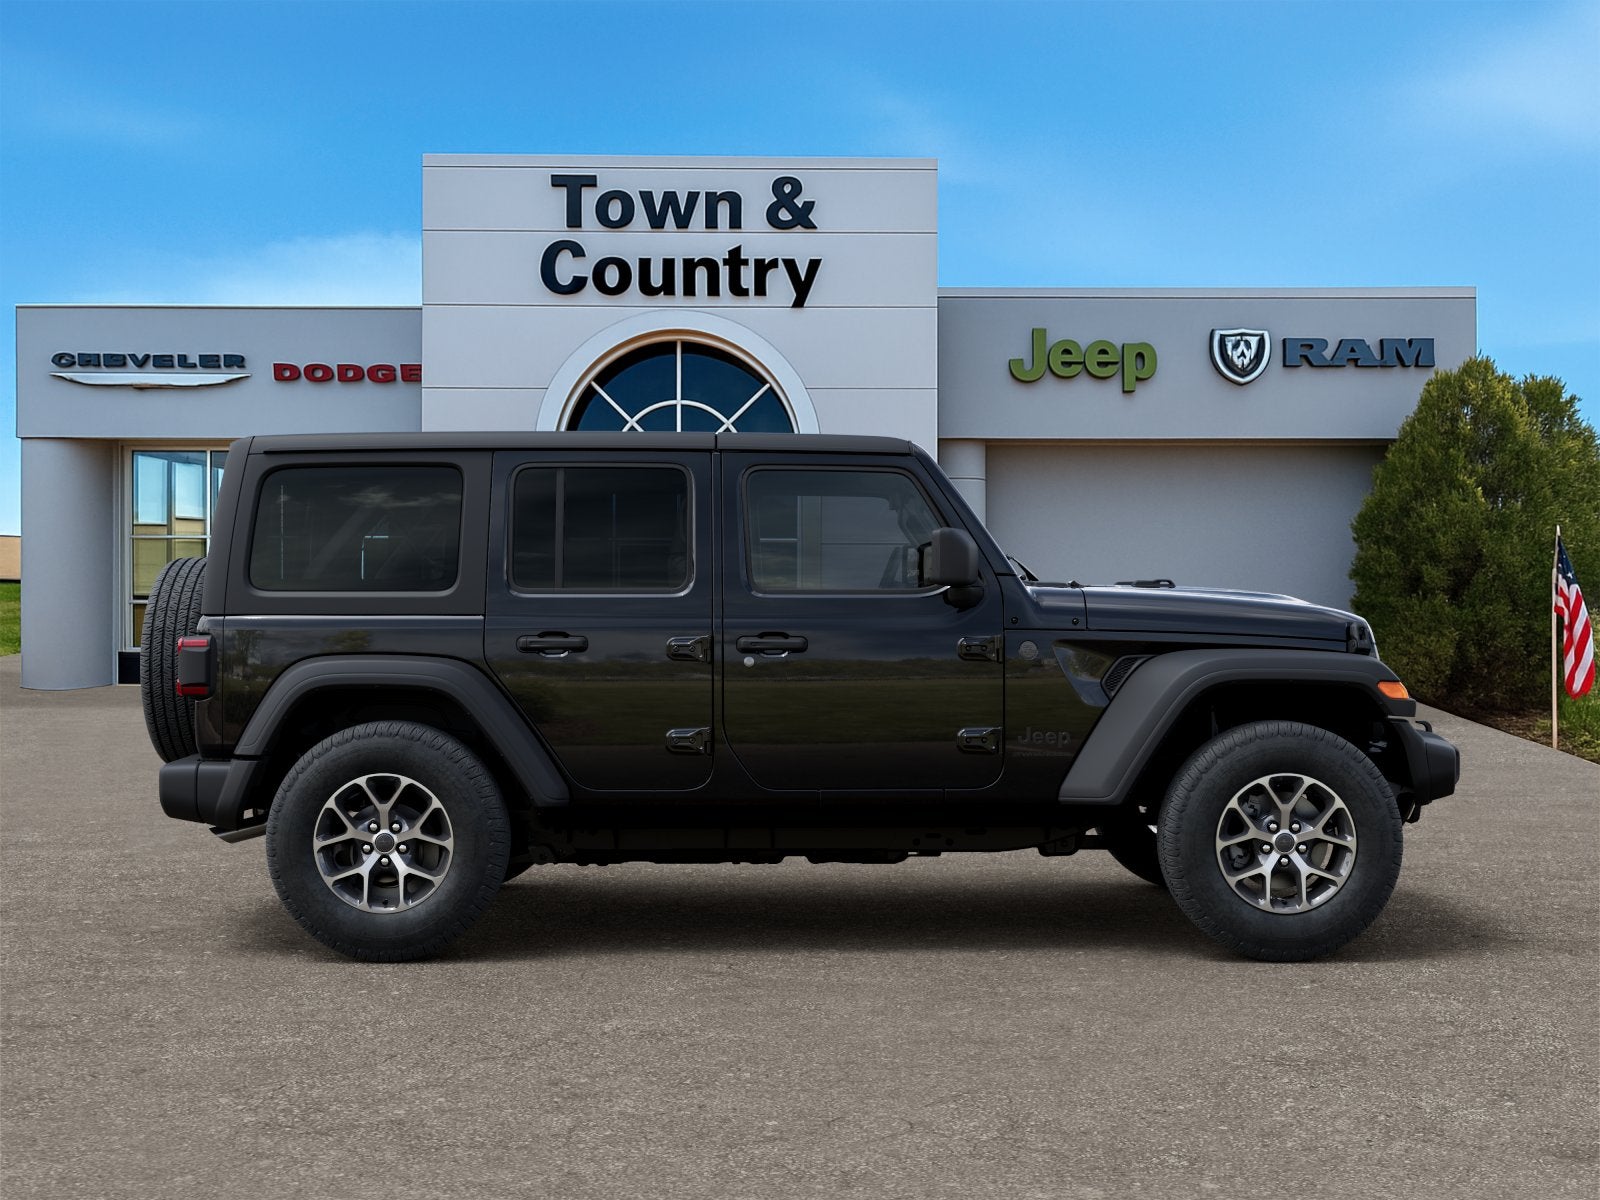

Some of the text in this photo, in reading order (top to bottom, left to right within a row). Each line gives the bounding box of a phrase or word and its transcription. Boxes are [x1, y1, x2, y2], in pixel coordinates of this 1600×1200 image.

[550, 174, 818, 230] Town &
[540, 239, 822, 308] Country
[272, 362, 422, 383] DODGE
[1009, 328, 1158, 393] Jeep
[1282, 337, 1435, 368] RAM
[1017, 726, 1072, 748] Jeep
